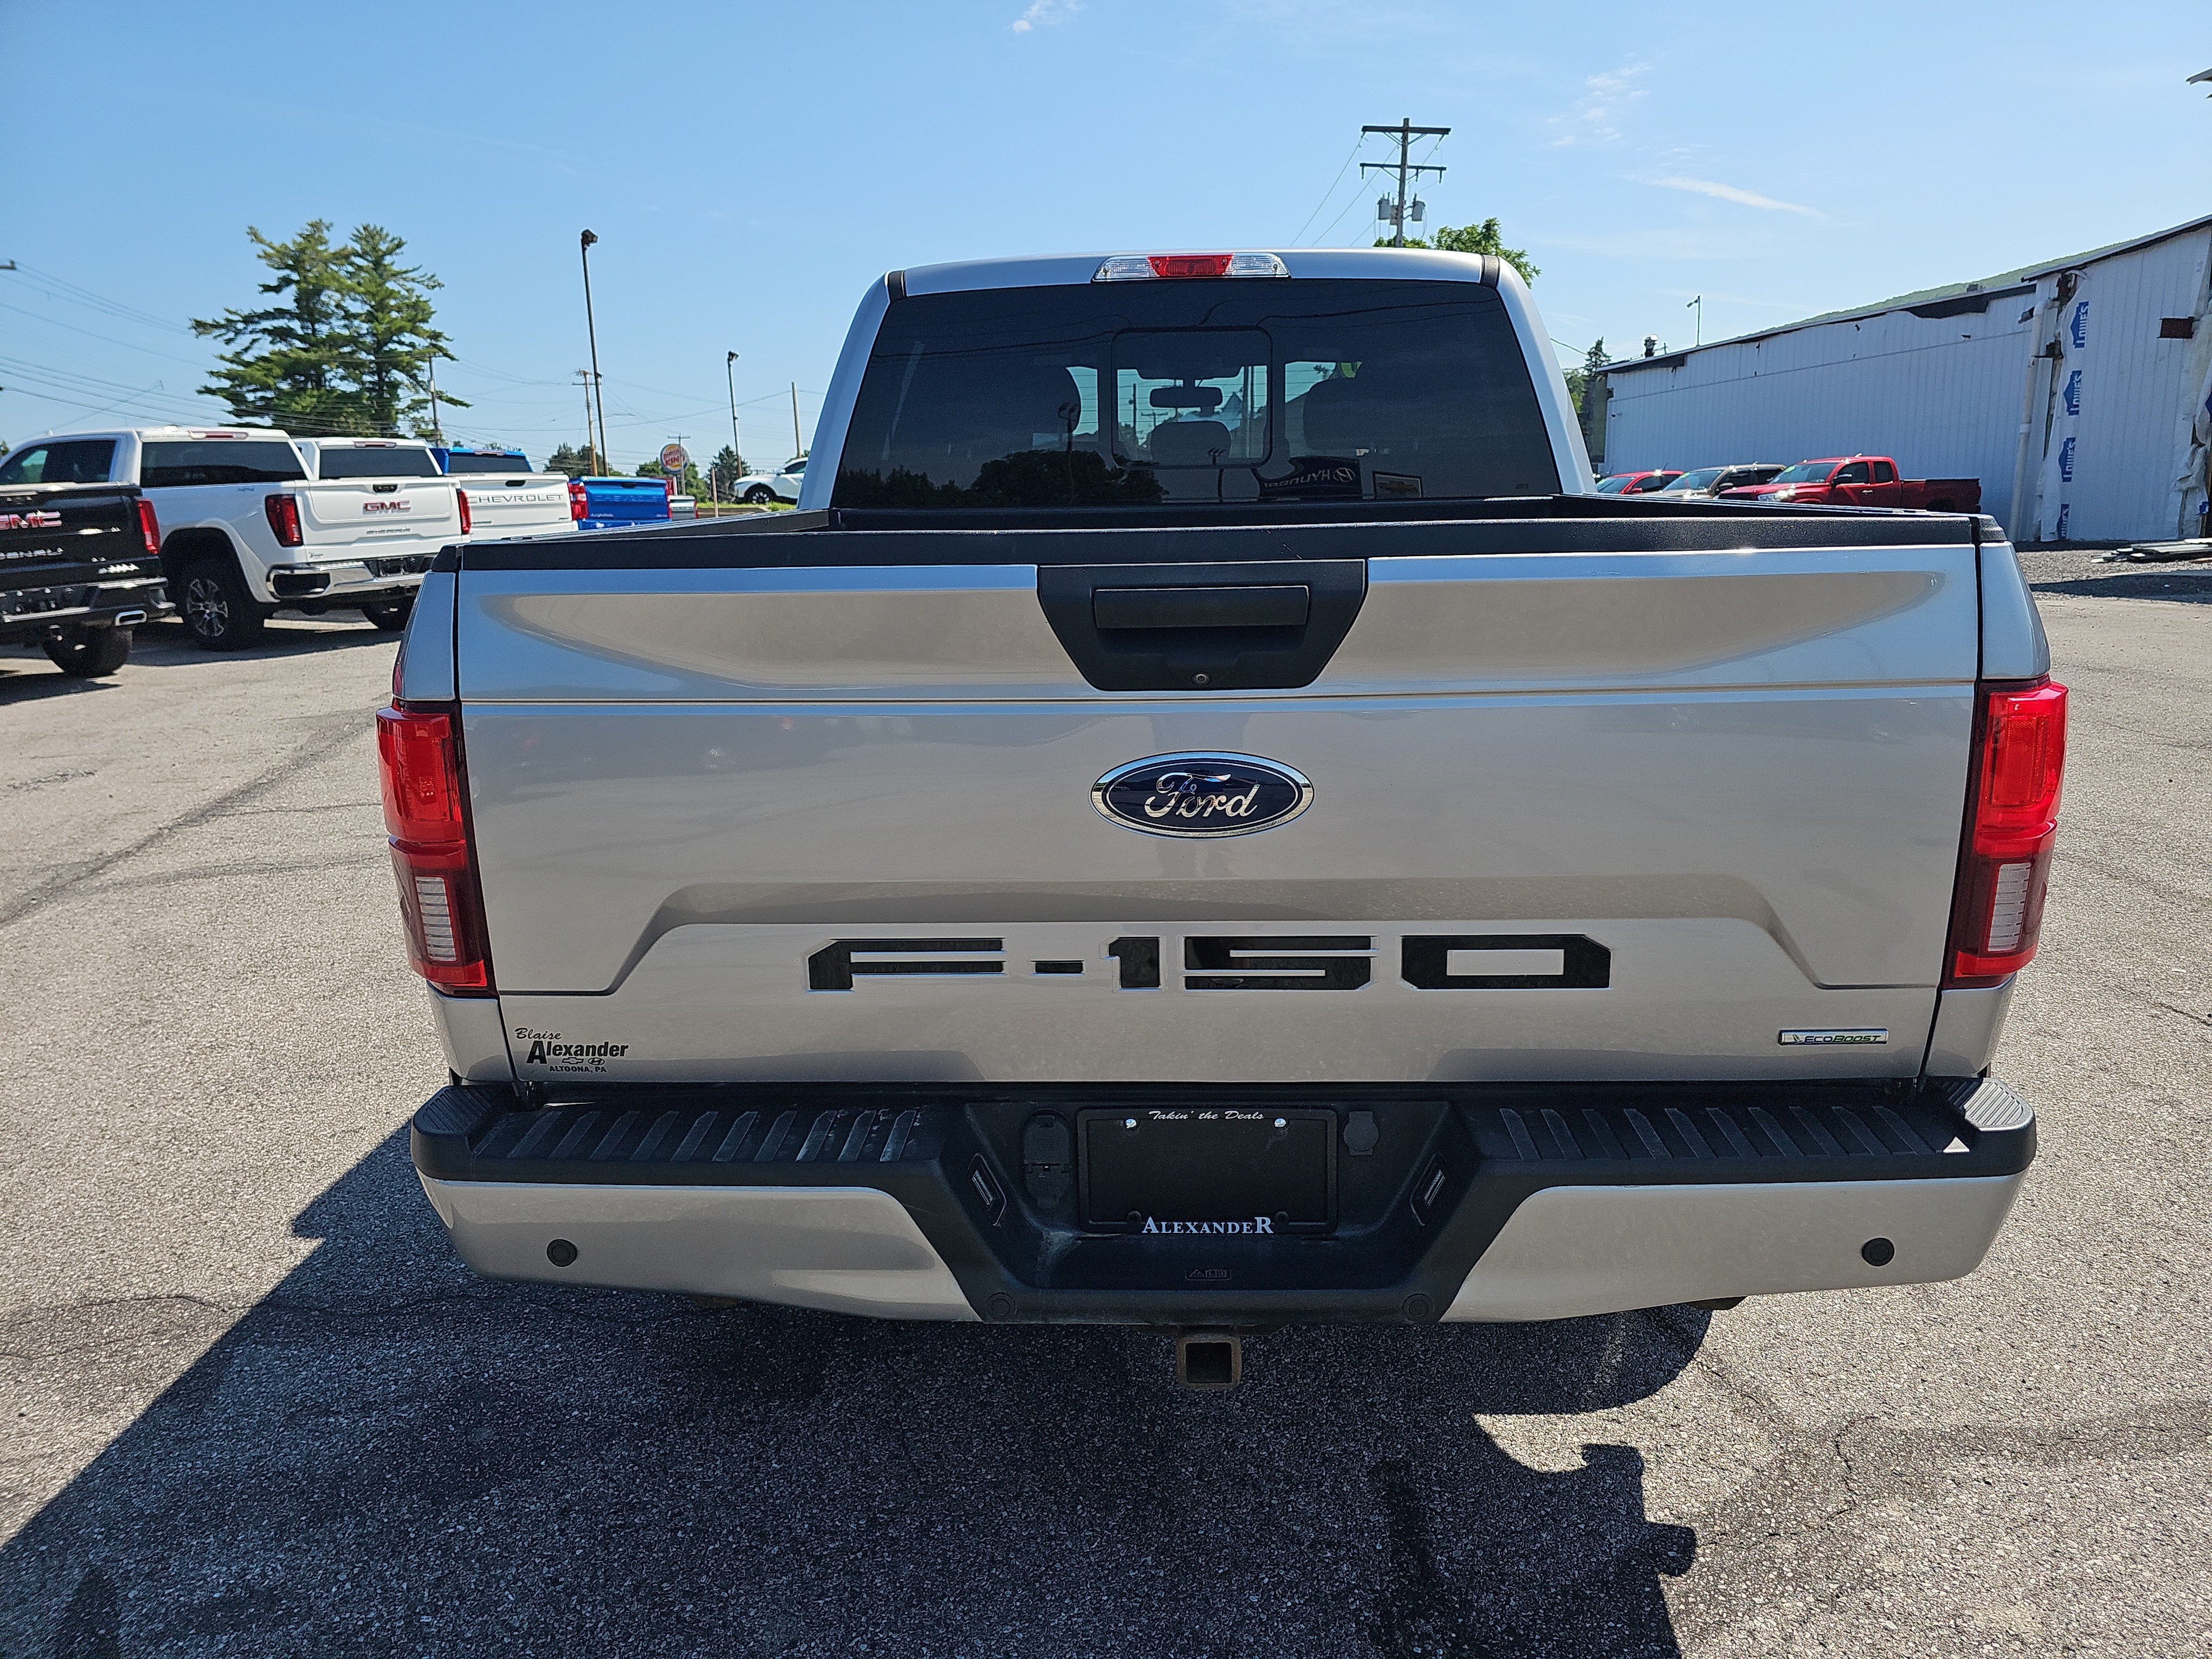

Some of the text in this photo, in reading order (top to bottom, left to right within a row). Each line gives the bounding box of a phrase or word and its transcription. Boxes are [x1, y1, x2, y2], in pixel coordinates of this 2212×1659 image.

[468, 493, 564, 504] CHEVROLET
[363, 500, 411, 513] GMC
[1144, 771, 1257, 818] Ford
[807, 935, 1613, 992] F-150
[515, 1027, 562, 1039] Blaise
[526, 1040, 629, 1064] Alexander
[549, 1065, 593, 1073] ALTOONA,
[1148, 1110, 1265, 1120] Takin' the Deals
